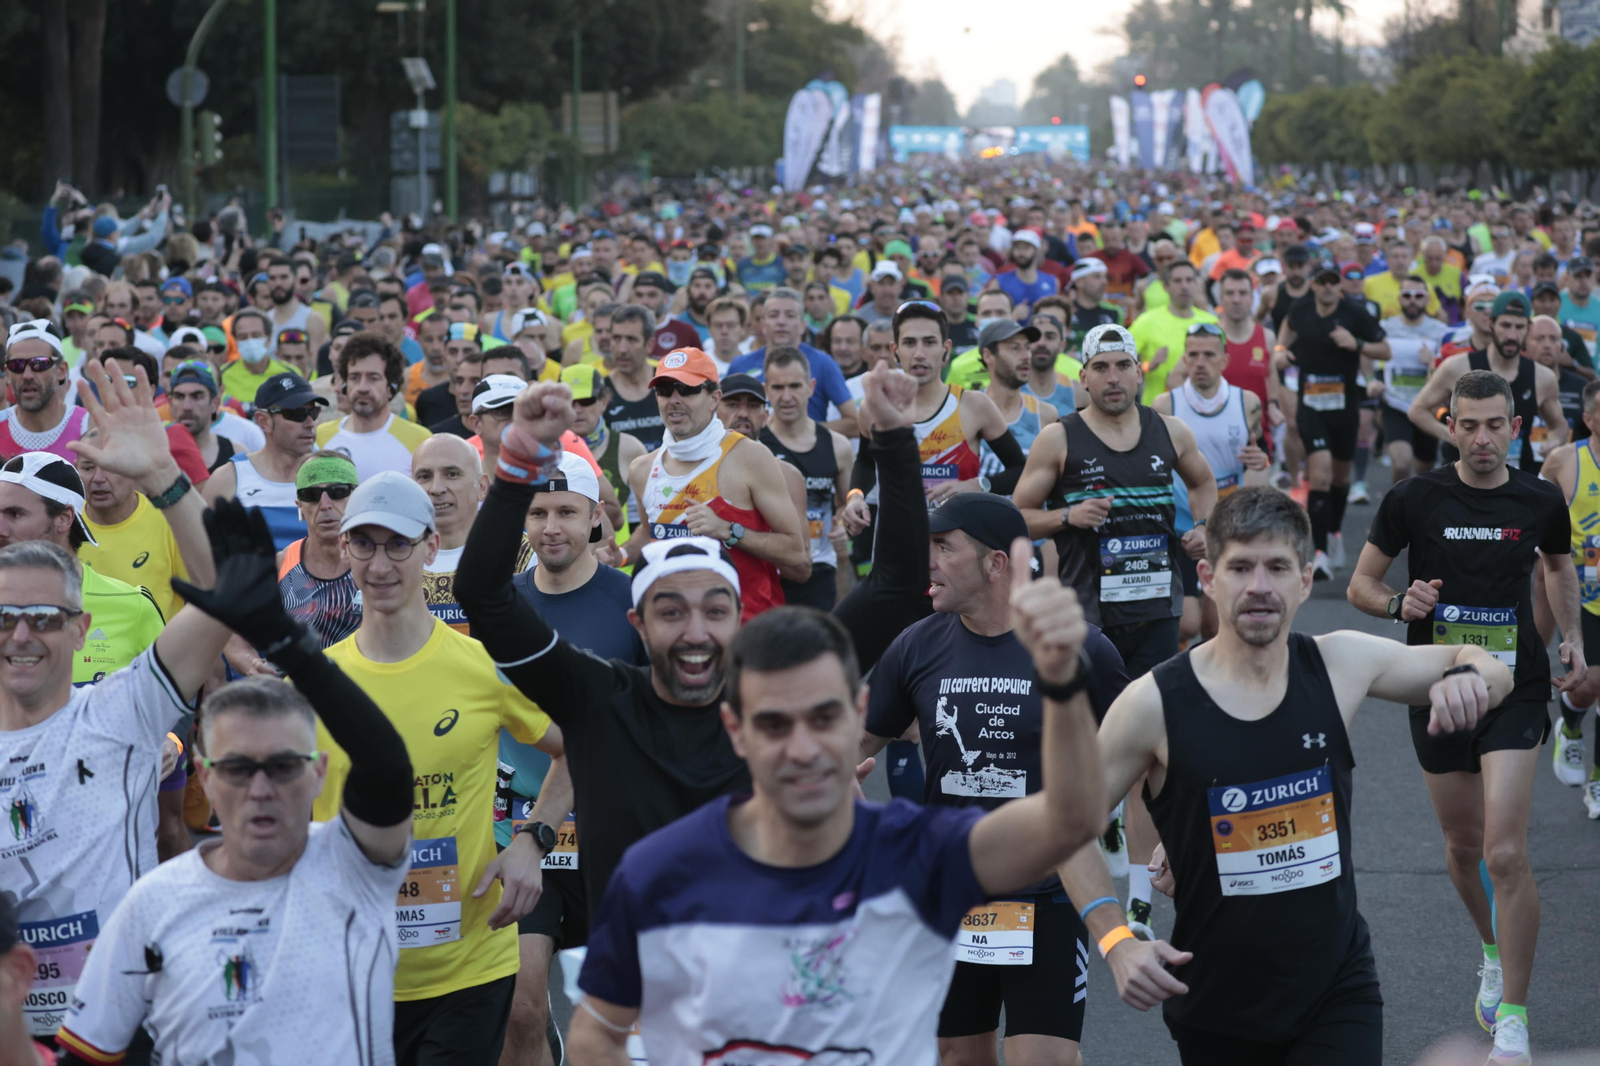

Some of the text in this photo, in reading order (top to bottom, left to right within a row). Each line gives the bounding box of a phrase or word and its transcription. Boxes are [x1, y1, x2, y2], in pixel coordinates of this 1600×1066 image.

[1081, 465, 1104, 475] HUUB
[685, 484, 700, 498] life
[1124, 538, 1160, 550] ZURICH
[1125, 559, 1149, 571] 2405
[1122, 574, 1151, 585] ALVARO
[1462, 610, 1509, 622] ZURICH
[1462, 633, 1488, 646] 1331
[951, 677, 989, 694] carrera
[990, 677, 1032, 695] popular
[975, 703, 1020, 716] Ciudad
[988, 715, 1005, 727] de
[978, 727, 1015, 740] Arcos
[985, 751, 997, 760] Mayo
[998, 751, 1005, 759] de
[1251, 776, 1319, 806] ZURICH
[1257, 818, 1297, 841] 3351
[555, 833, 576, 846] 74
[411, 848, 441, 862] ICH
[545, 855, 572, 866] ALEX
[1257, 845, 1305, 866] TOMÁS
[963, 912, 998, 926] 3637
[20, 920, 83, 944] URICH
[972, 935, 988, 944] NA
